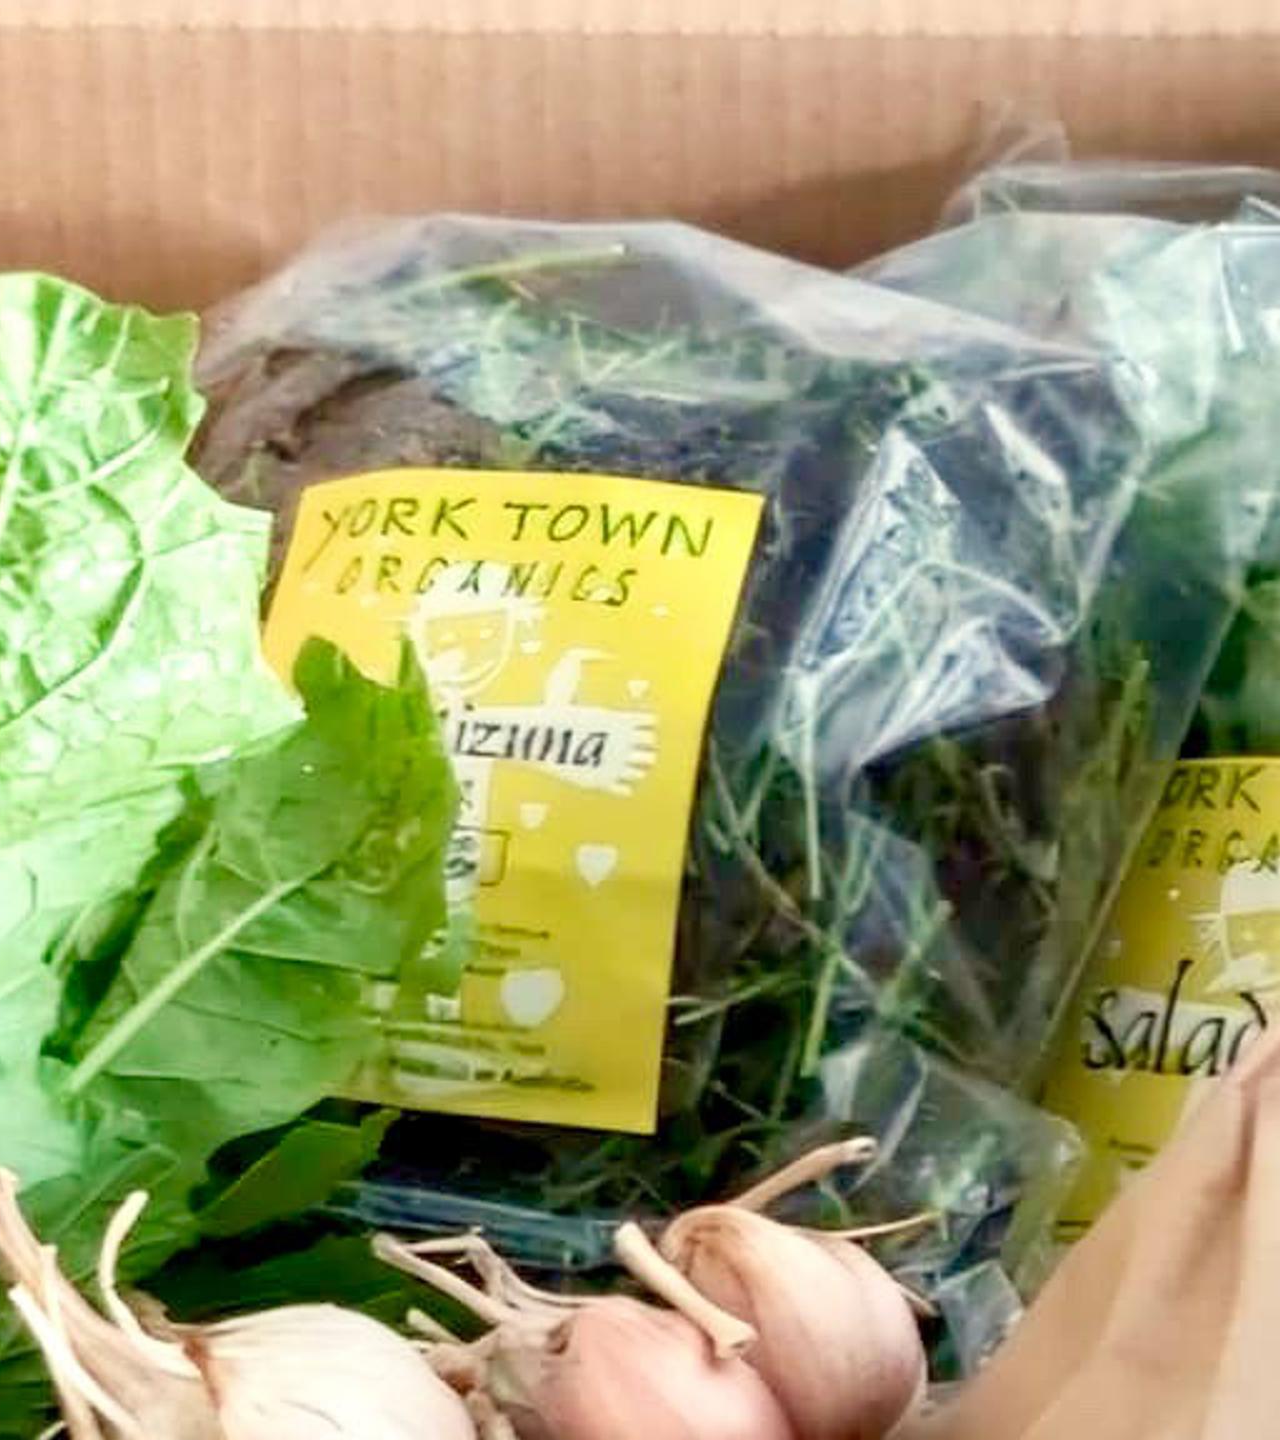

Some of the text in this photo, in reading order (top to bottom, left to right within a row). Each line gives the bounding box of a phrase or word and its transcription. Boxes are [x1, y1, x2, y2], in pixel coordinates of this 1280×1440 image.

[302, 495, 715, 572] YORK TOWN
[335, 554, 640, 608] ORGANICS
[439, 703, 611, 769] izuna
[1158, 764, 1266, 814] ORK
